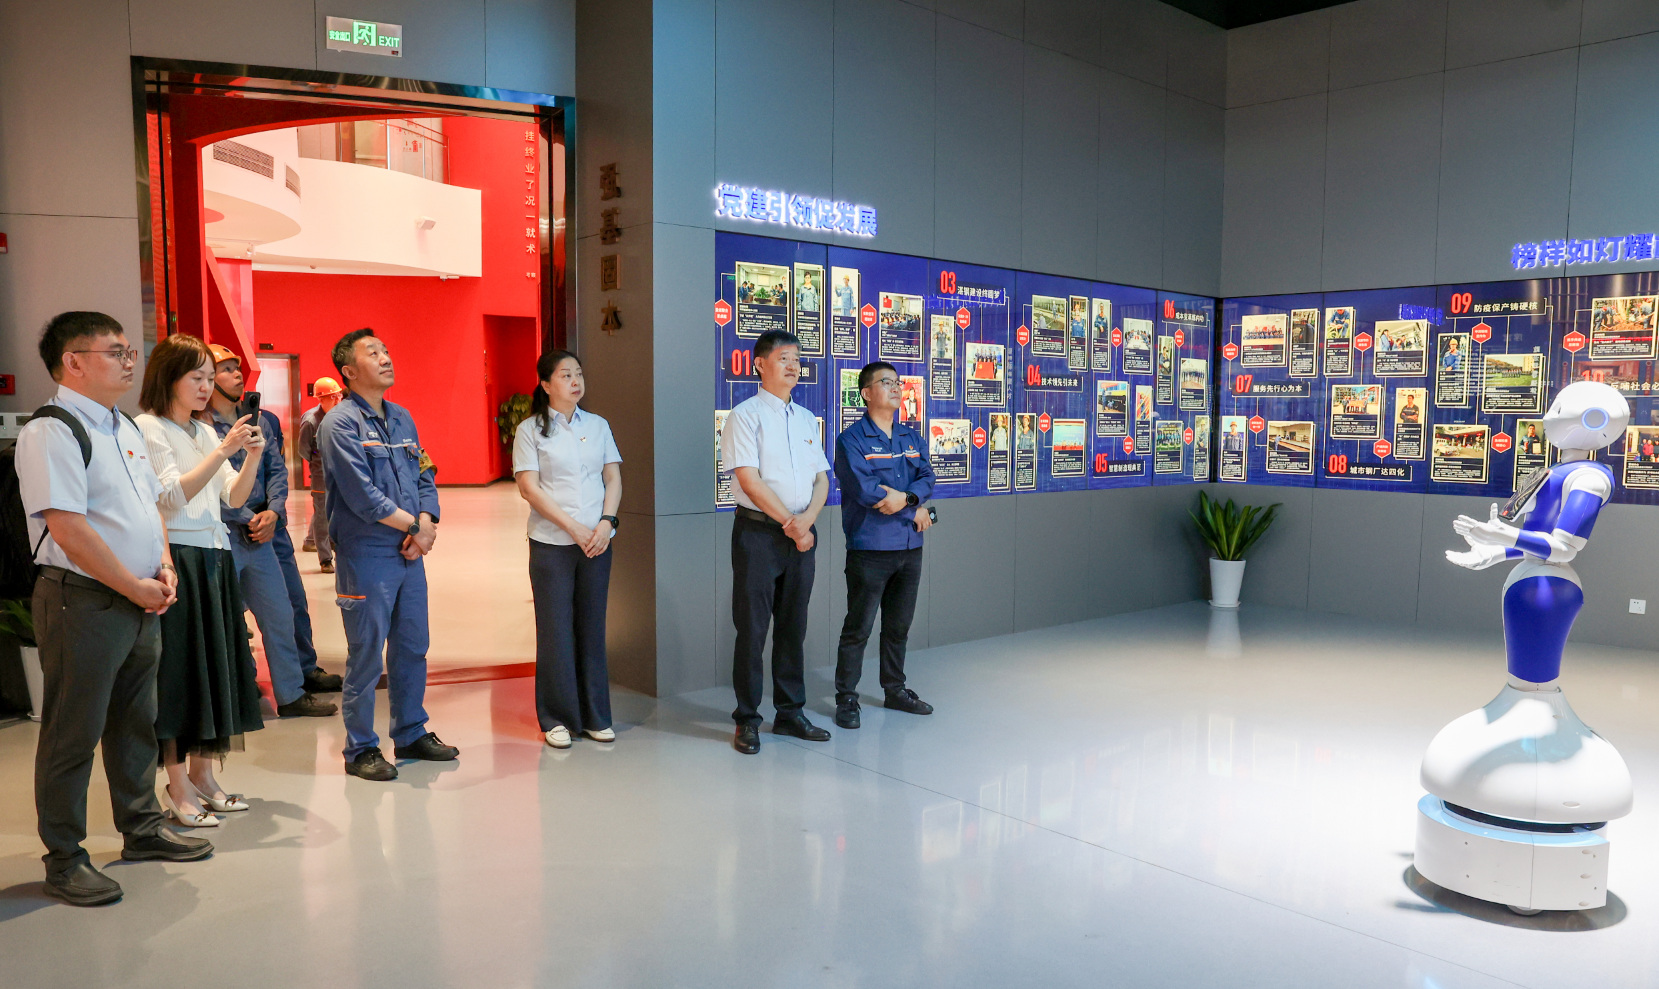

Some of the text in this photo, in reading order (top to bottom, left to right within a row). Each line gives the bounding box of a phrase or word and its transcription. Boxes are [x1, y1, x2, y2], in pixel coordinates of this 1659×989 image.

[328, 29, 351, 42] 安全出口
[378, 35, 401, 48] EXIT
[716, 182, 879, 237] 党建引领促发展
[1510, 232, 1659, 270] 榜样如灯耀
[940, 270, 957, 294] 03
[1164, 299, 1176, 319] 06
[1450, 292, 1538, 314] 09 防疫保产铸硬核
[731, 348, 751, 376] 01
[1027, 364, 1078, 387] 04 技术领先引未来
[1235, 374, 1303, 393] 07 服务先行心为本
[1095, 453, 1108, 473] 05
[1328, 454, 1406, 477] 08 城市钢厂达四化
